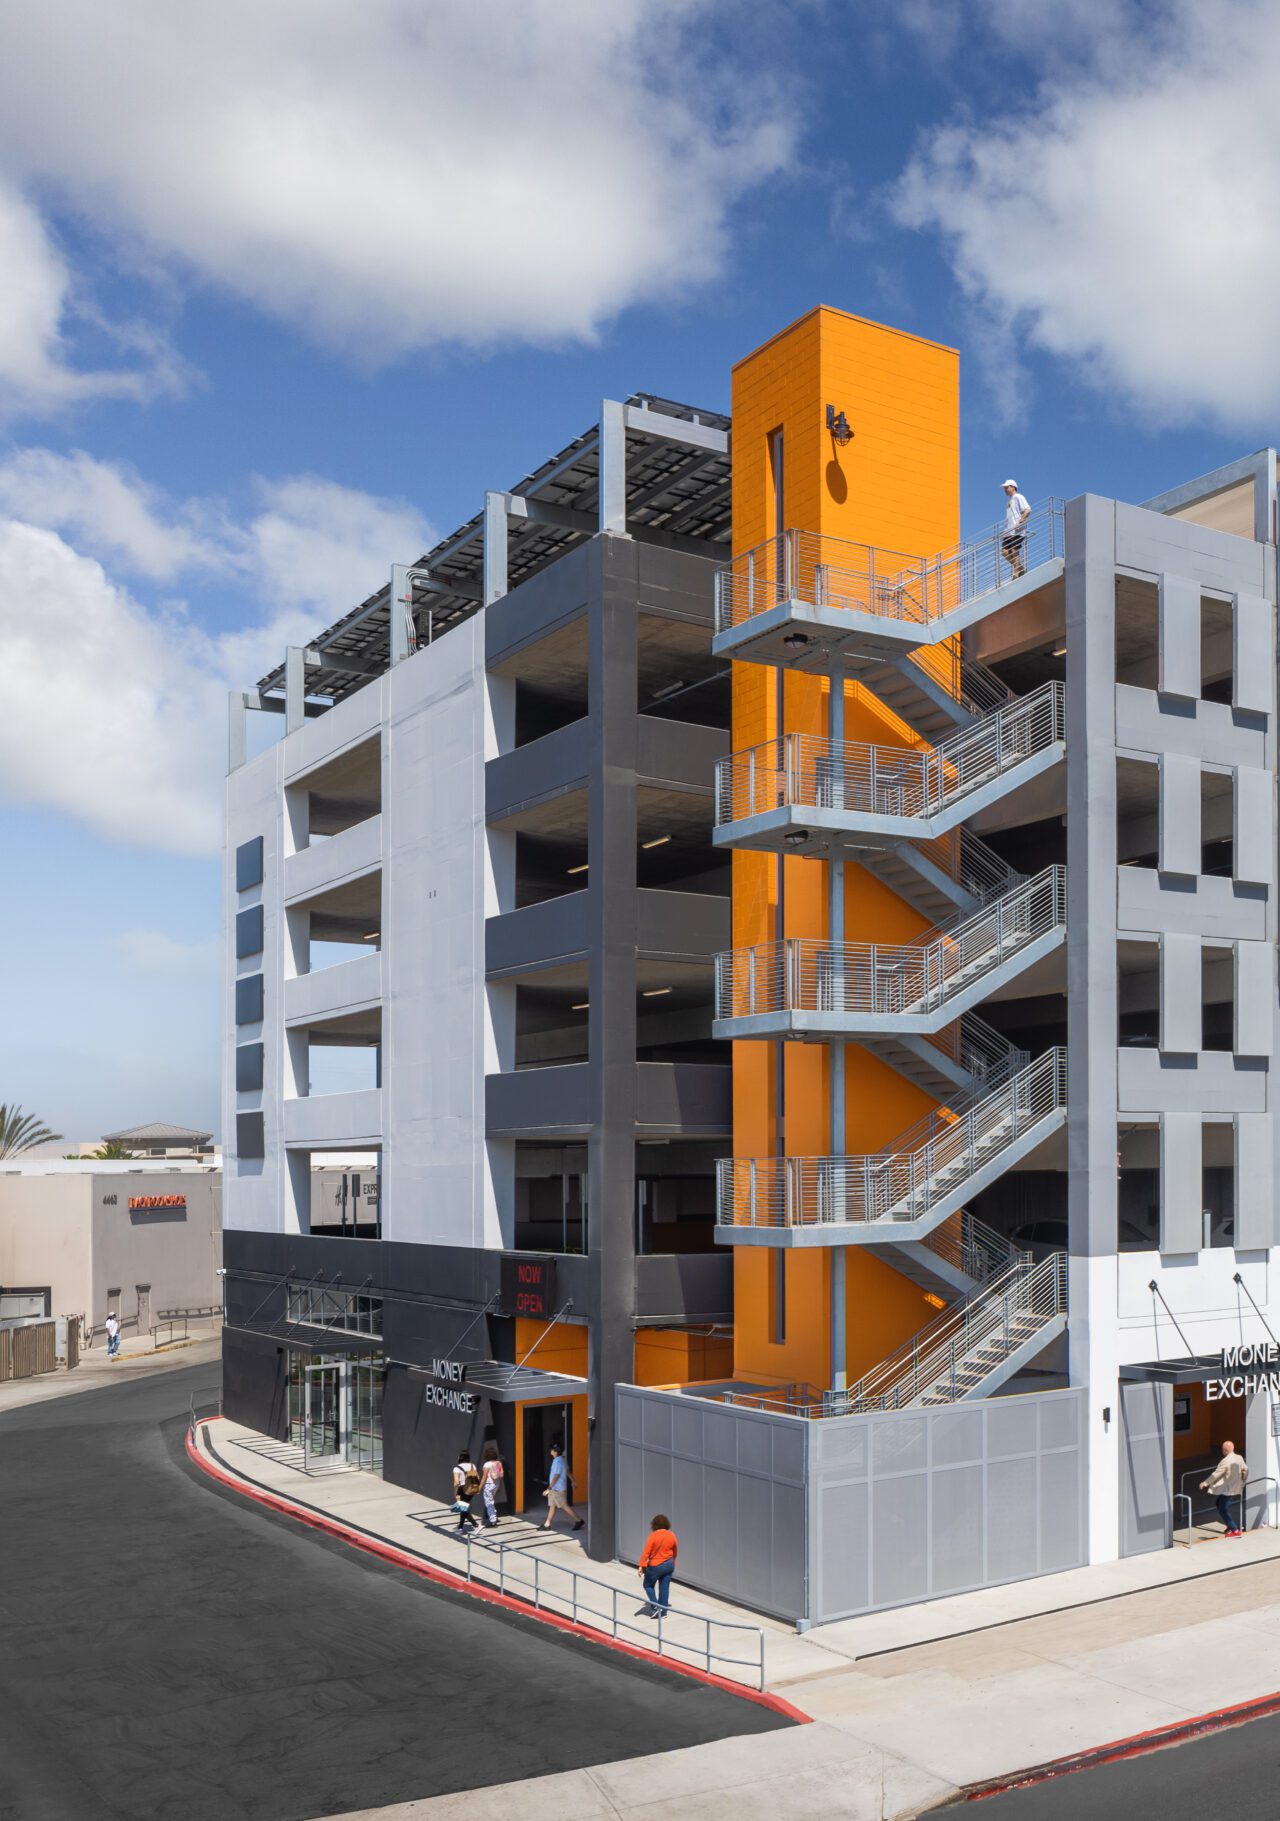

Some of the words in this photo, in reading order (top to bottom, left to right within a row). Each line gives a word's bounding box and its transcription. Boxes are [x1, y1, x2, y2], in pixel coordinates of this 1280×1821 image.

[518, 1264, 541, 1284] NOW
[516, 1293, 543, 1313] OPEN
[432, 1358, 465, 1382] MONEY
[426, 1384, 474, 1413] EXCHANGE
